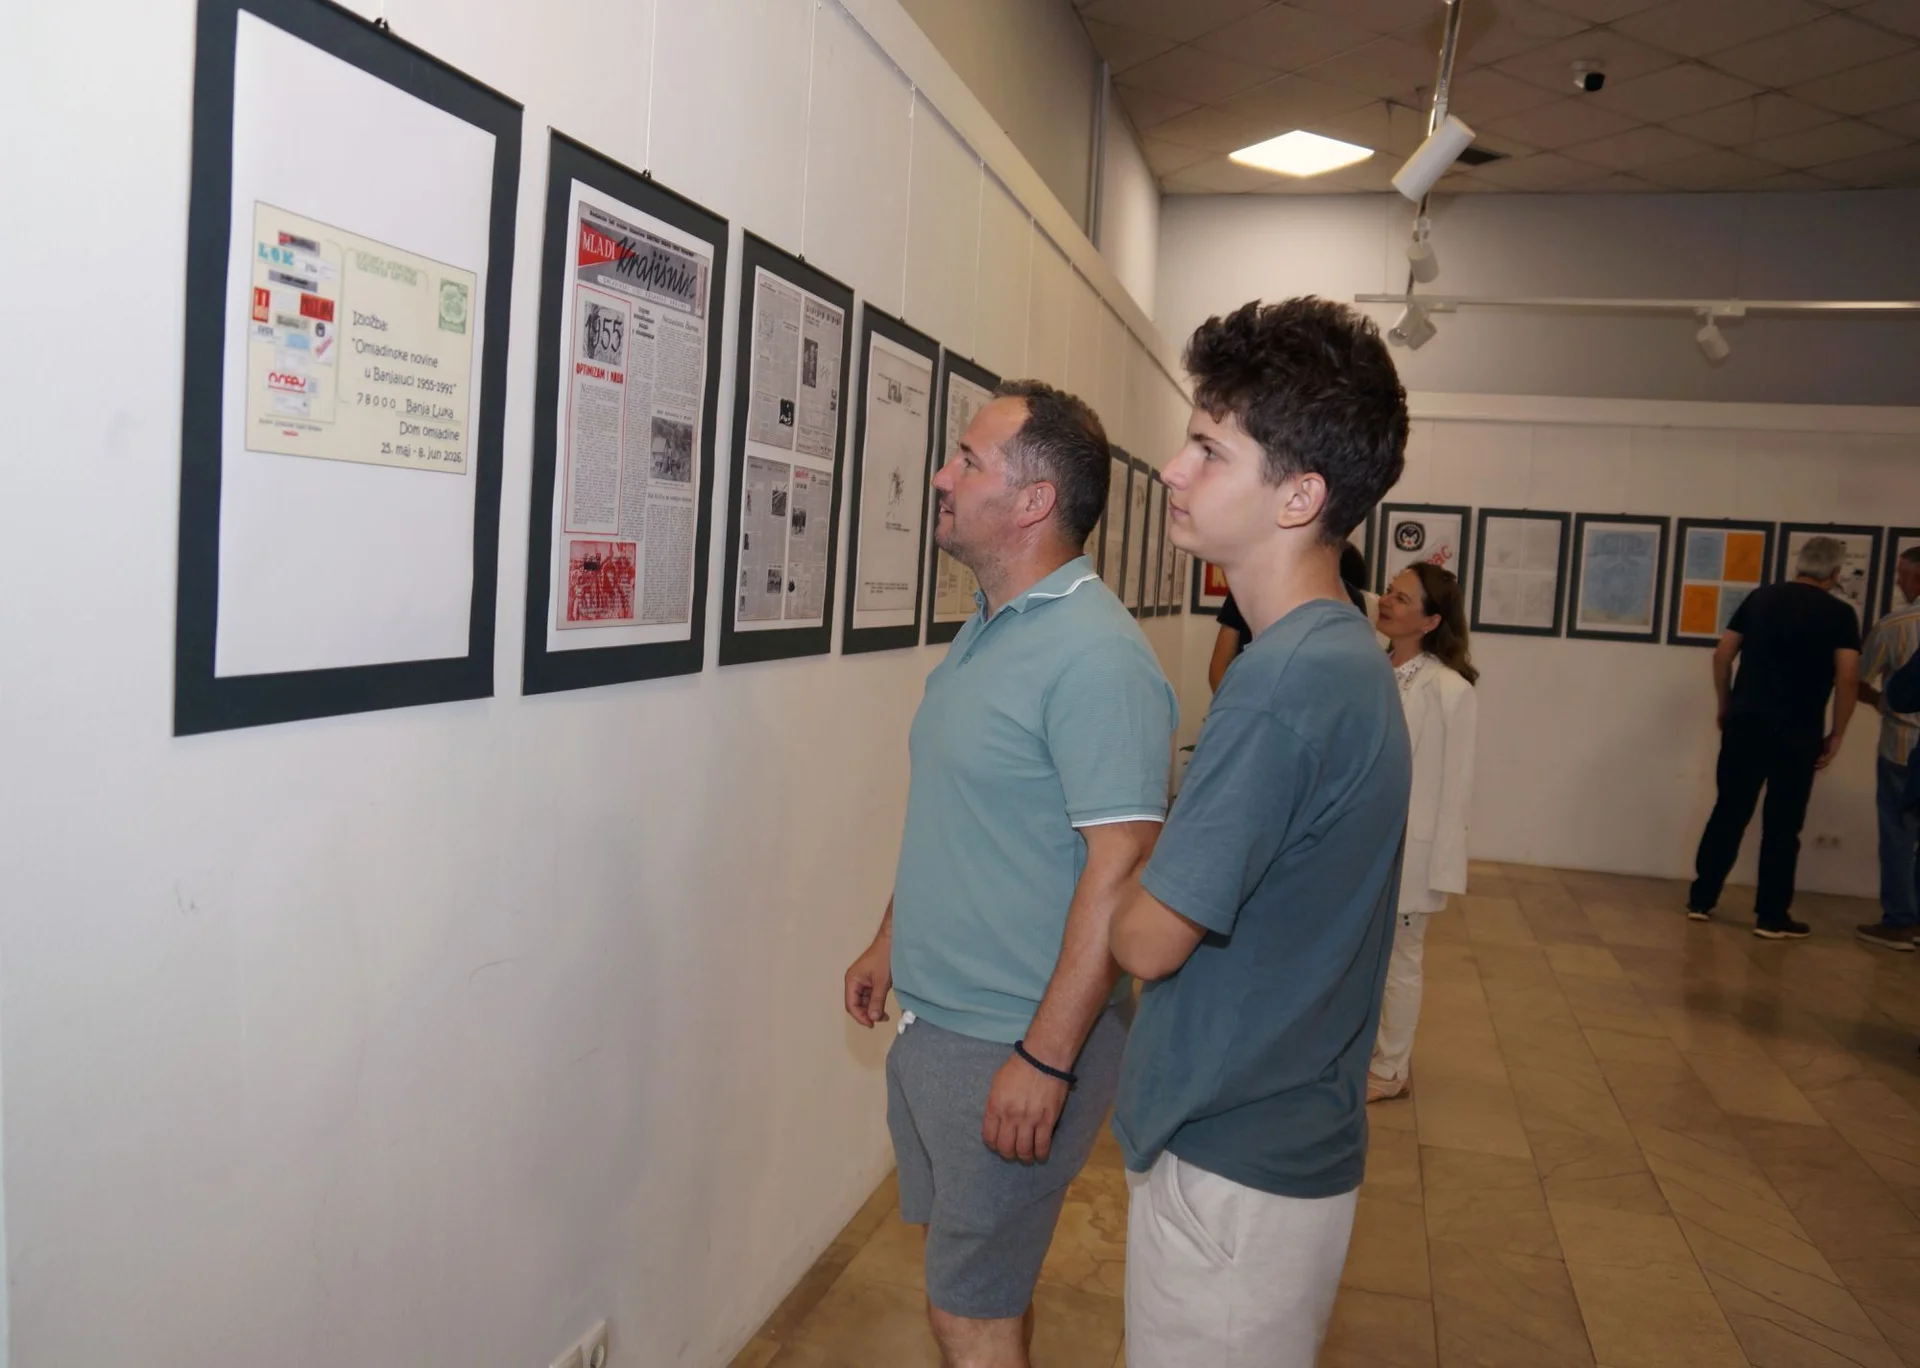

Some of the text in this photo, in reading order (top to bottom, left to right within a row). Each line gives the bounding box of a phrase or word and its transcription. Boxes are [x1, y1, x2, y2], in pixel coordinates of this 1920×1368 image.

[582, 231, 616, 260] MLADI
[410, 353, 439, 369] novine
[364, 368, 371, 379] u
[373, 366, 415, 387] Banjaluci
[406, 398, 430, 415] Banja
[432, 403, 454, 419] Luka
[399, 420, 460, 441] Dom omladine
[395, 444, 411, 458] maj
[427, 445, 442, 460] jun
